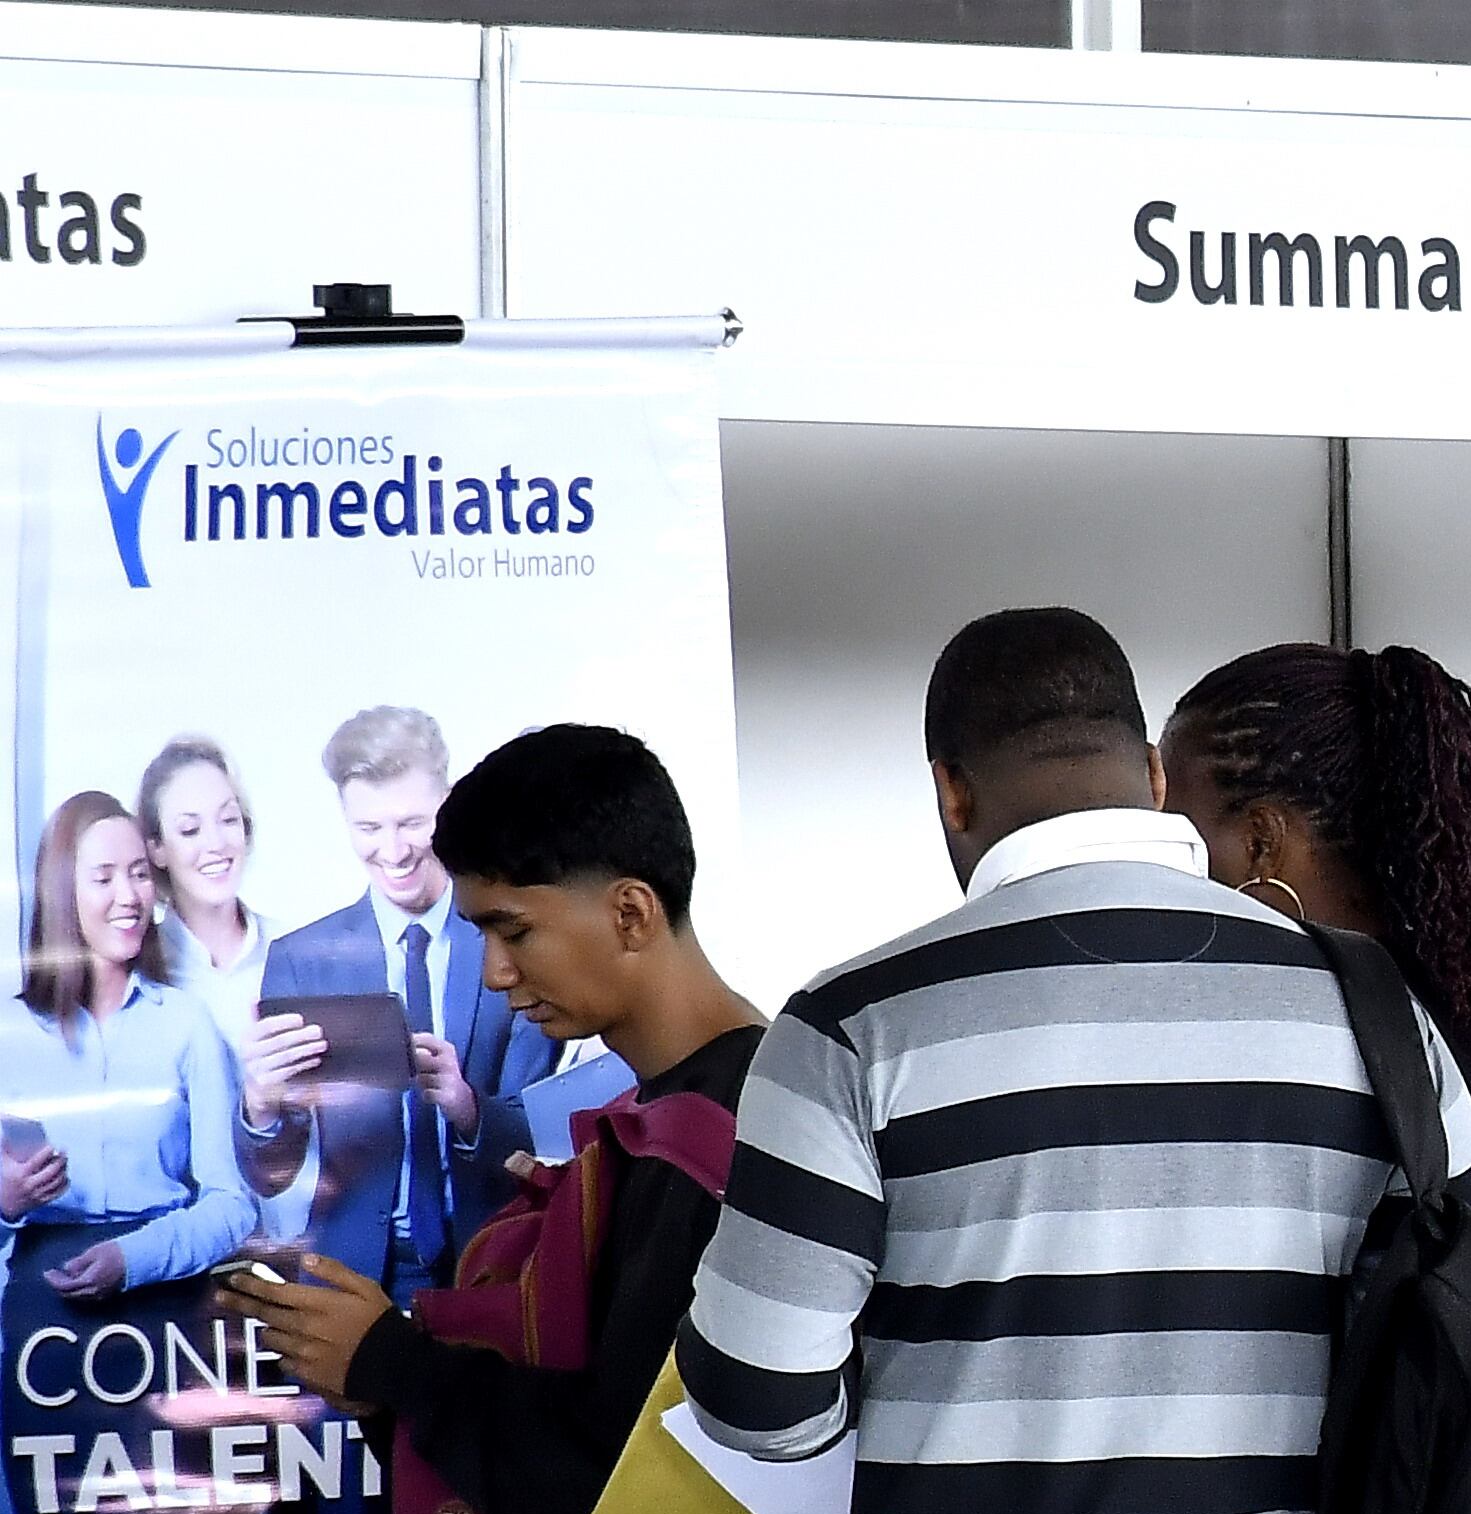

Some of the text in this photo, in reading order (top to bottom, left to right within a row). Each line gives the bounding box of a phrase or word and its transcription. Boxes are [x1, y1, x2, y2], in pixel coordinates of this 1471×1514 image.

[206, 427, 395, 468] Soluciones
[184, 455, 597, 543] Inmediatas
[411, 549, 597, 581] Valor Humano
